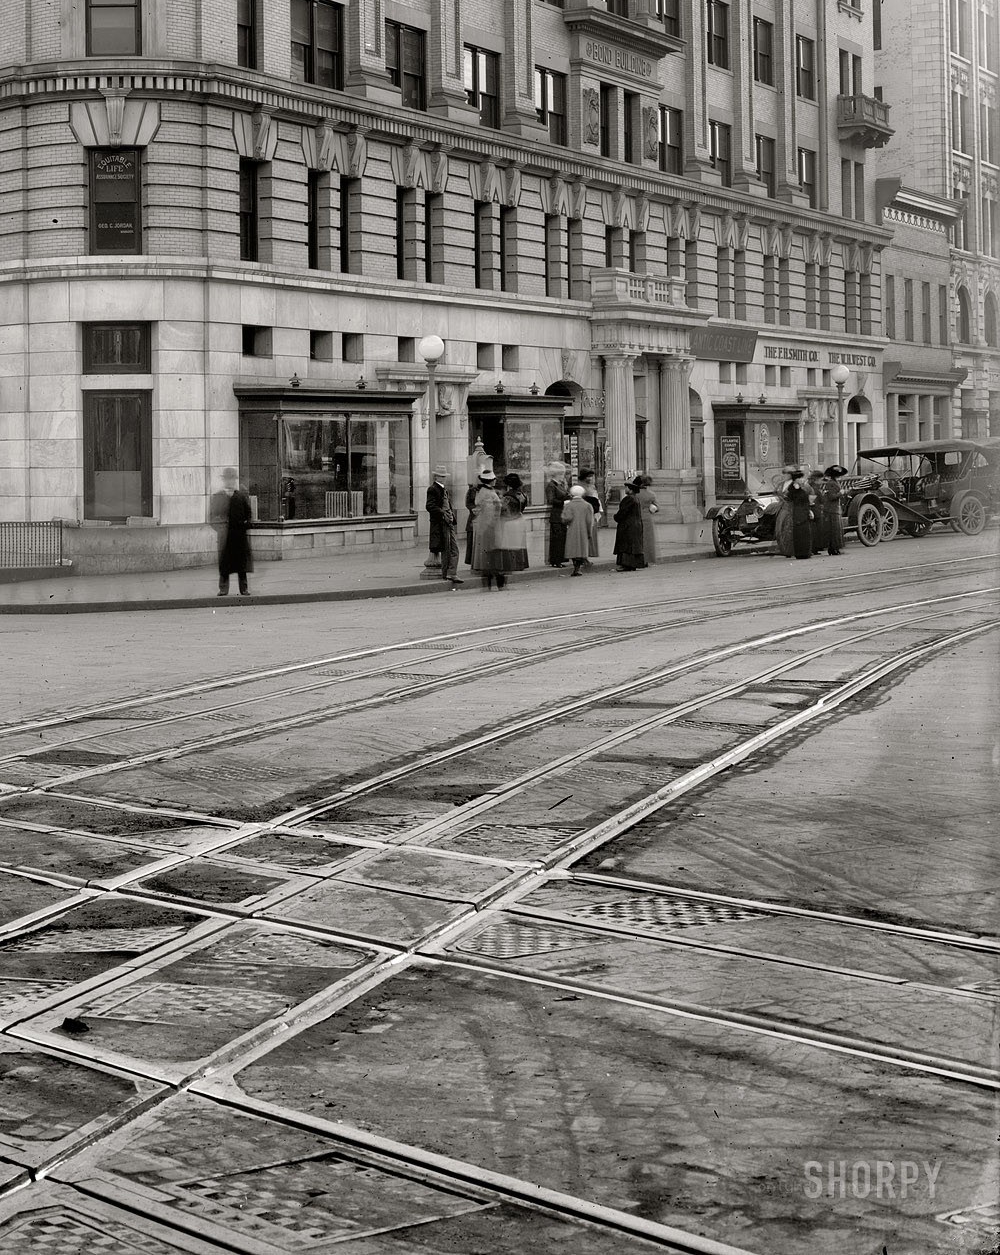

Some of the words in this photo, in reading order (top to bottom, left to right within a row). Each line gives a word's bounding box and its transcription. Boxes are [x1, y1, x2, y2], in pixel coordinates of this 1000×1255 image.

[592, 42, 612, 65] BOND
[615, 50, 646, 77] BUILDING
[97, 155, 132, 170] EQUITABLE
[106, 165, 124, 173] LIFE
[764, 346, 777, 359] THE
[828, 352, 840, 364] THE
